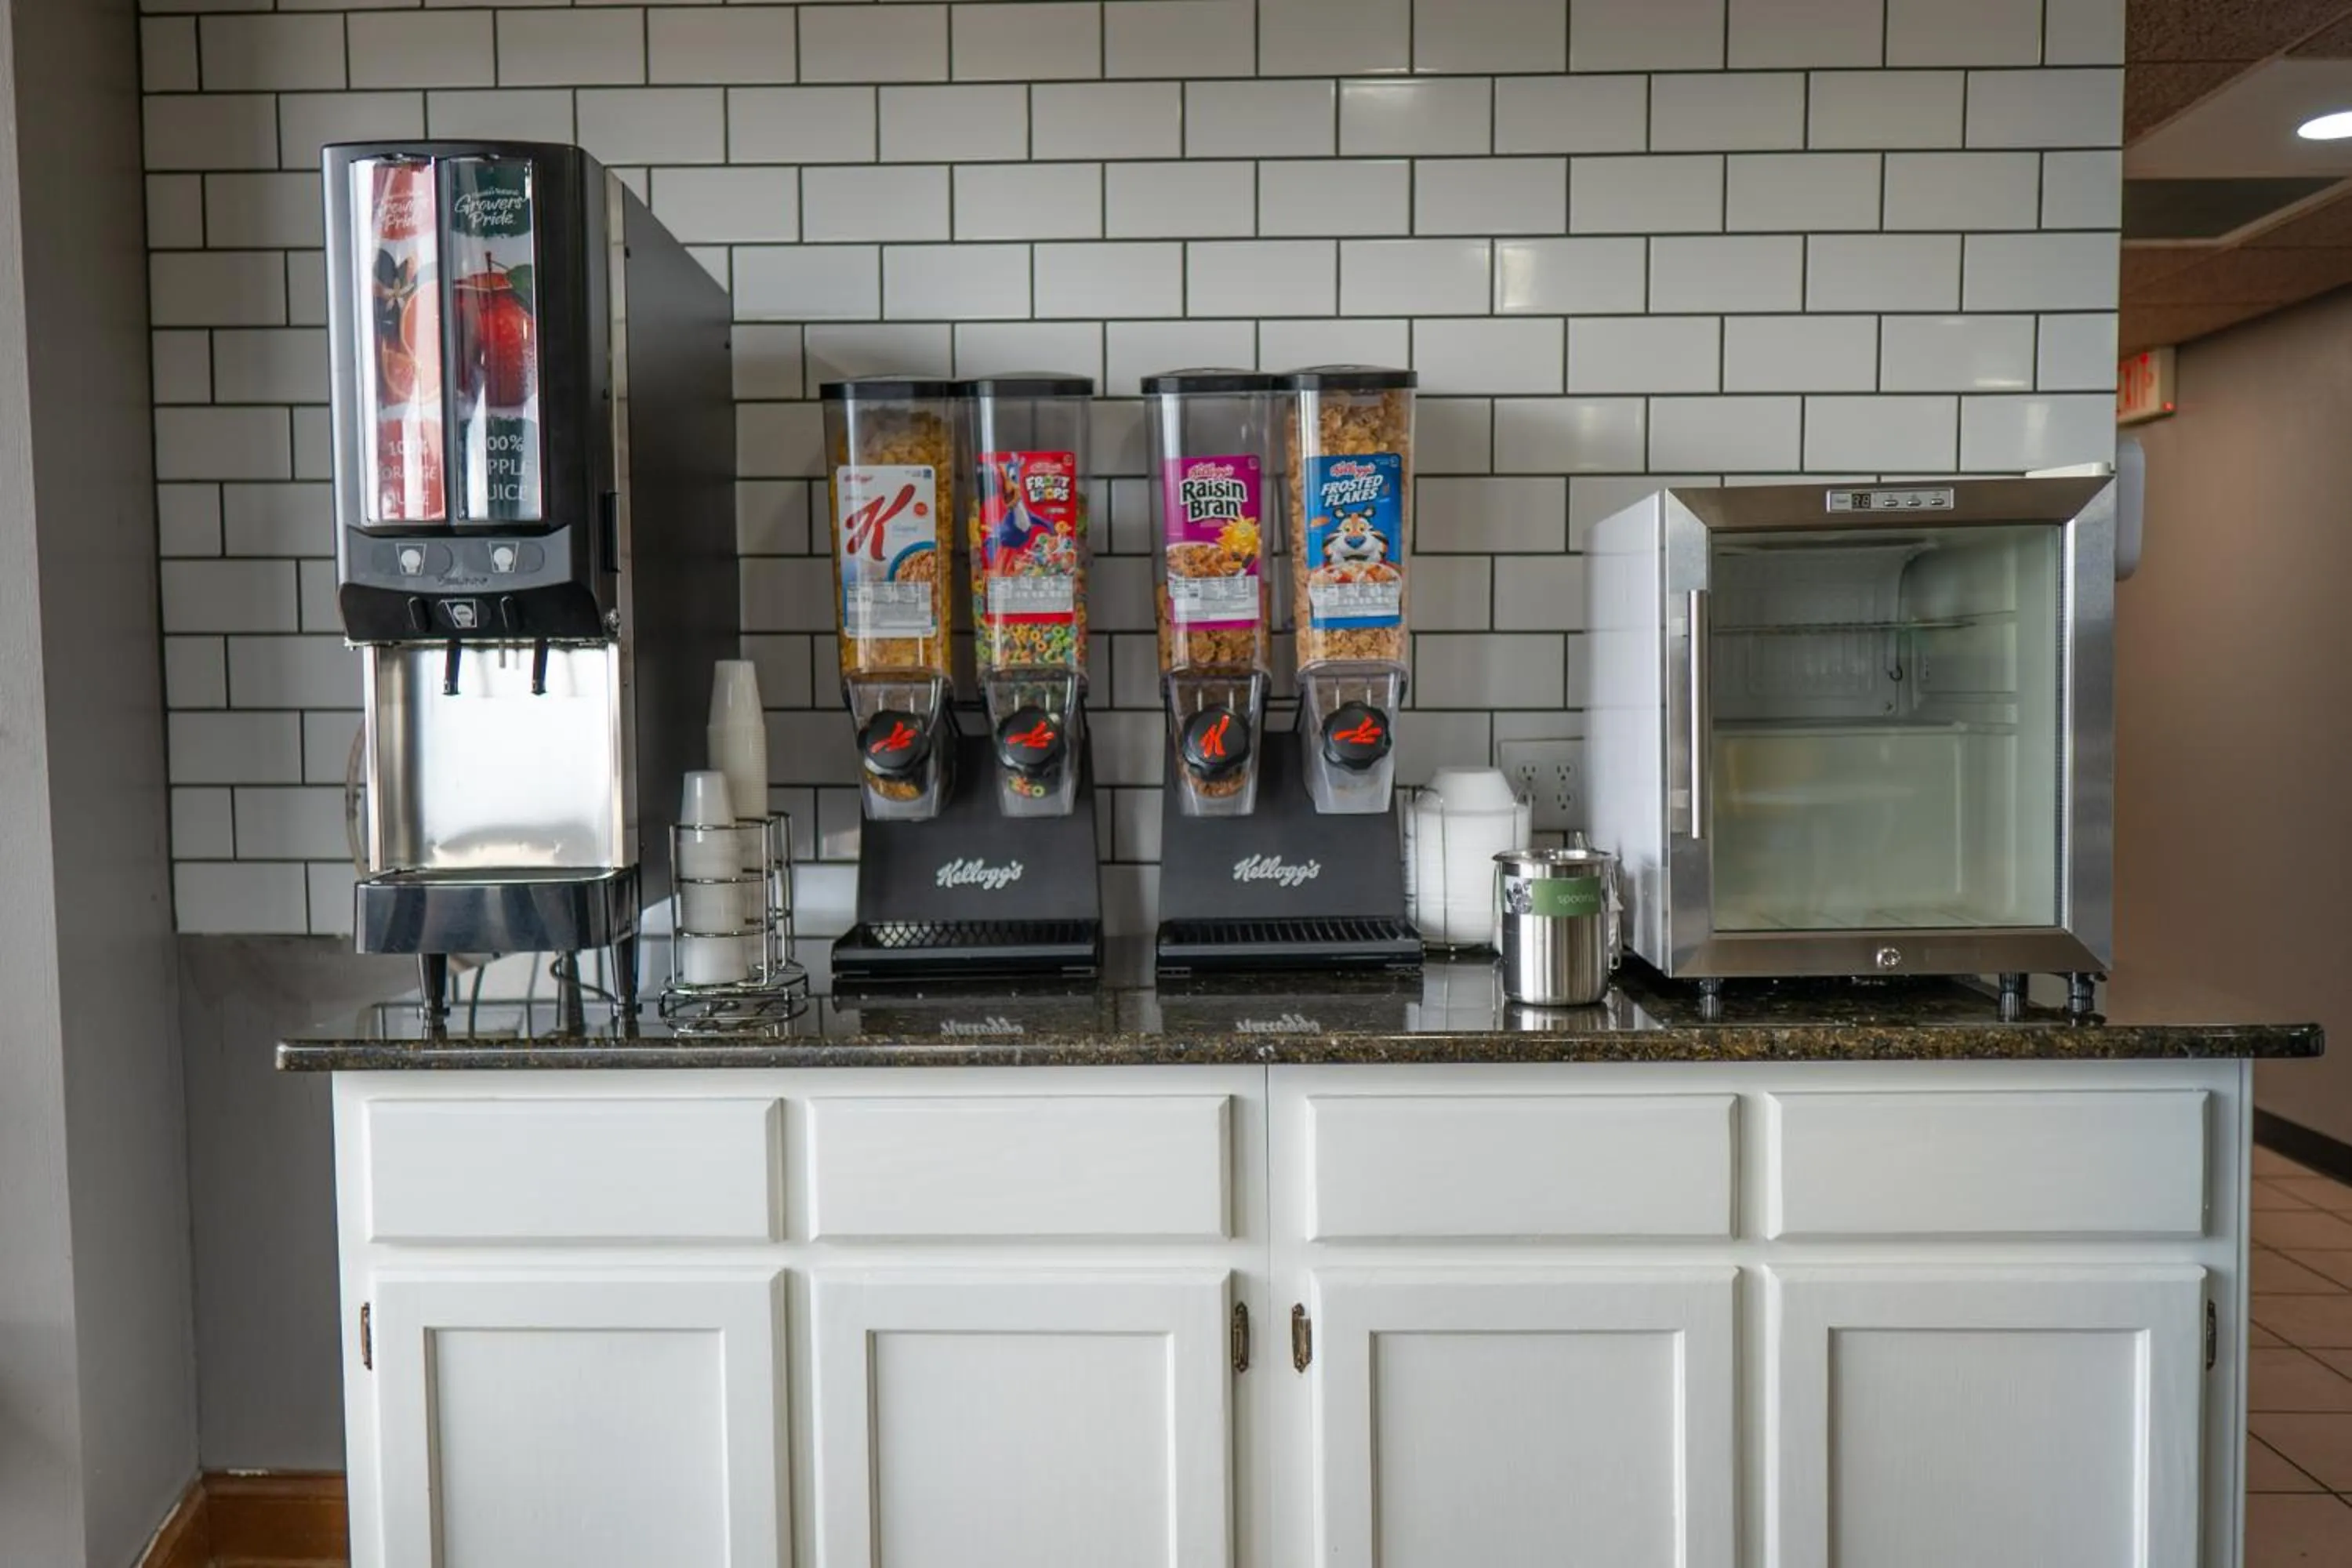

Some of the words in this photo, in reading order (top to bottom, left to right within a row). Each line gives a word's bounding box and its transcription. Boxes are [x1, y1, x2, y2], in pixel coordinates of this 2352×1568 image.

[470, 209, 515, 229] Pride
[487, 434, 524, 452] 00%
[487, 459, 533, 475] PPLE
[488, 483, 527, 501] UICE
[1029, 487, 1069, 503] LOOPS
[1181, 478, 1246, 503] Raisin
[1321, 474, 1384, 496] FROSTED
[1324, 487, 1377, 507] FLAKES
[1190, 499, 1240, 519] Bran
[846, 483, 916, 561] K
[936, 857, 1023, 890] Kellogg's
[1233, 853, 1321, 887] Kellogg's
